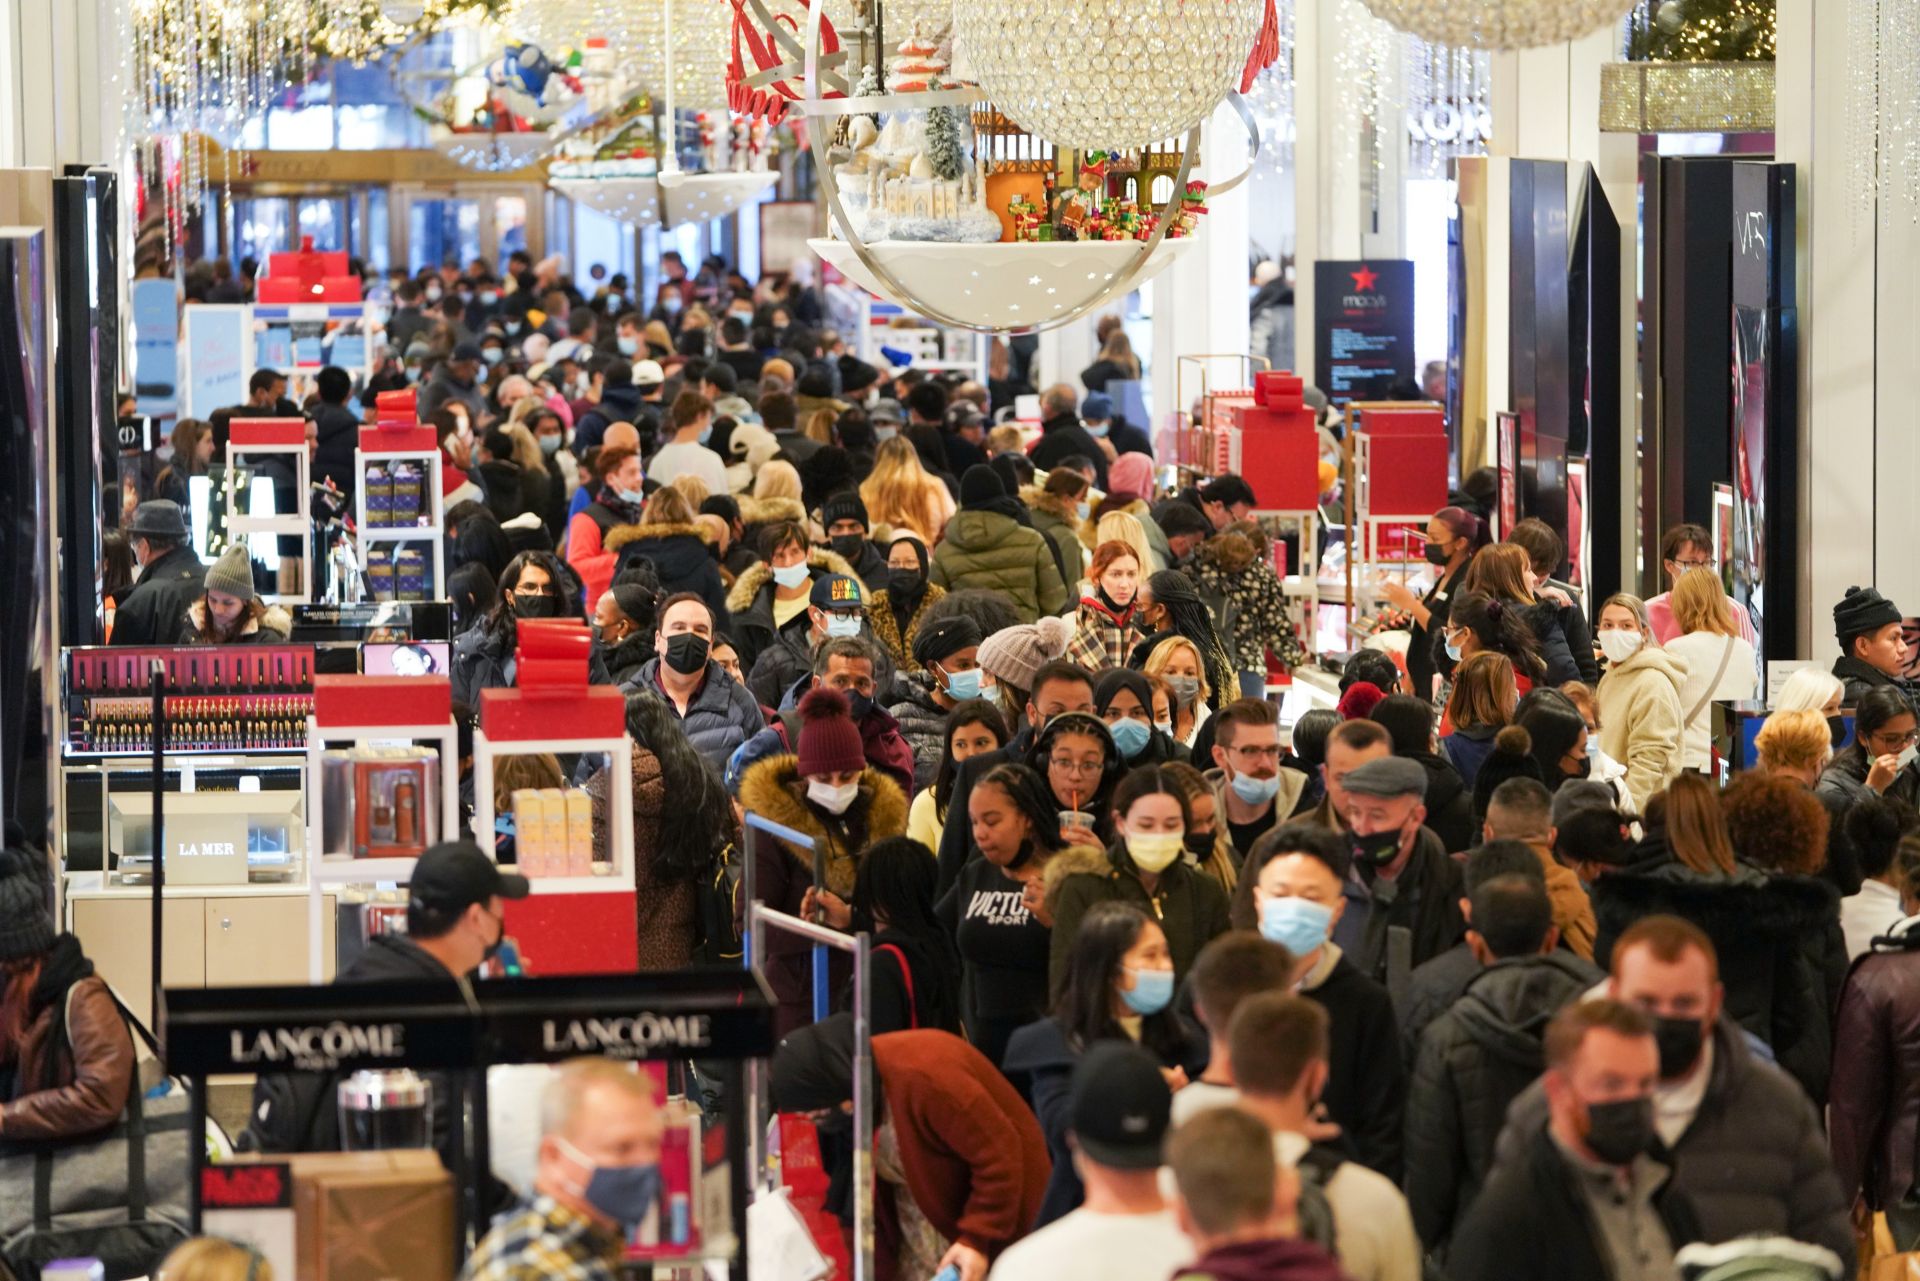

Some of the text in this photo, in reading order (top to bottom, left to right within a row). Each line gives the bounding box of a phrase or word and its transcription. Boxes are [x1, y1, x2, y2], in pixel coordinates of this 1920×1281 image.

[179, 843, 235, 856] LA MER
[988, 914, 1029, 925] SPORT
[230, 1020, 405, 1062] LANCÔME
[542, 1011, 712, 1052] LANCÔME
